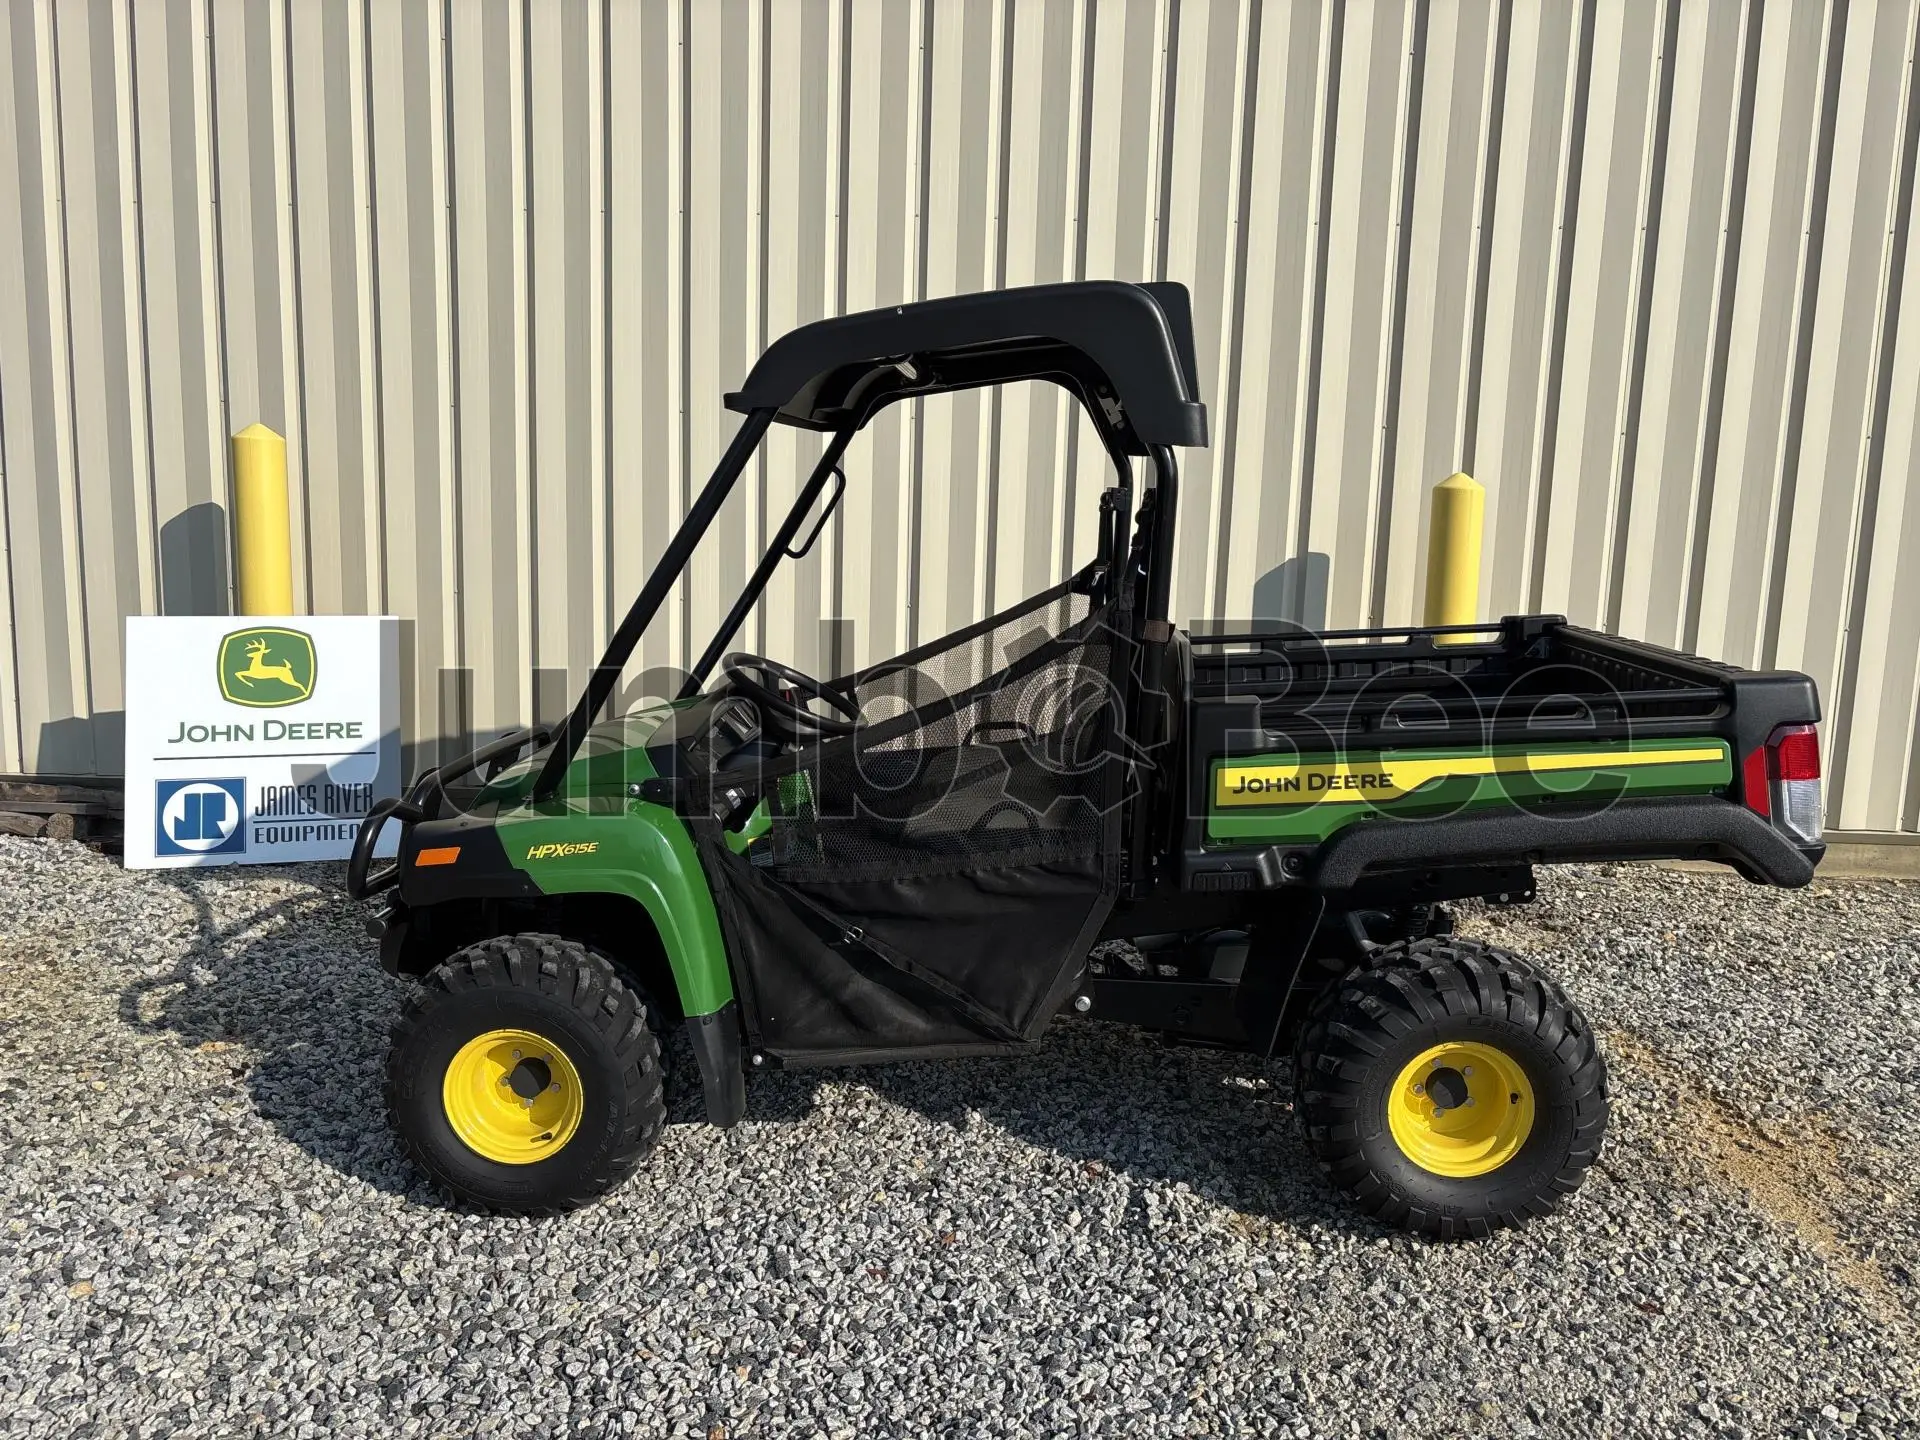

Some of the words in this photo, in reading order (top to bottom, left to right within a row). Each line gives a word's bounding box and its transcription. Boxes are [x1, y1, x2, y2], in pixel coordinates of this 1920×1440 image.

[168, 721, 254, 744] JOHN
[263, 719, 363, 741] DEERE
[1233, 776, 1300, 794] JOHN
[1308, 773, 1394, 792] DEERE
[255, 784, 317, 817] JAMES
[324, 783, 374, 815] RIVER
[254, 823, 362, 845] EQUIPMEN
[526, 842, 599, 860] HPX615E
